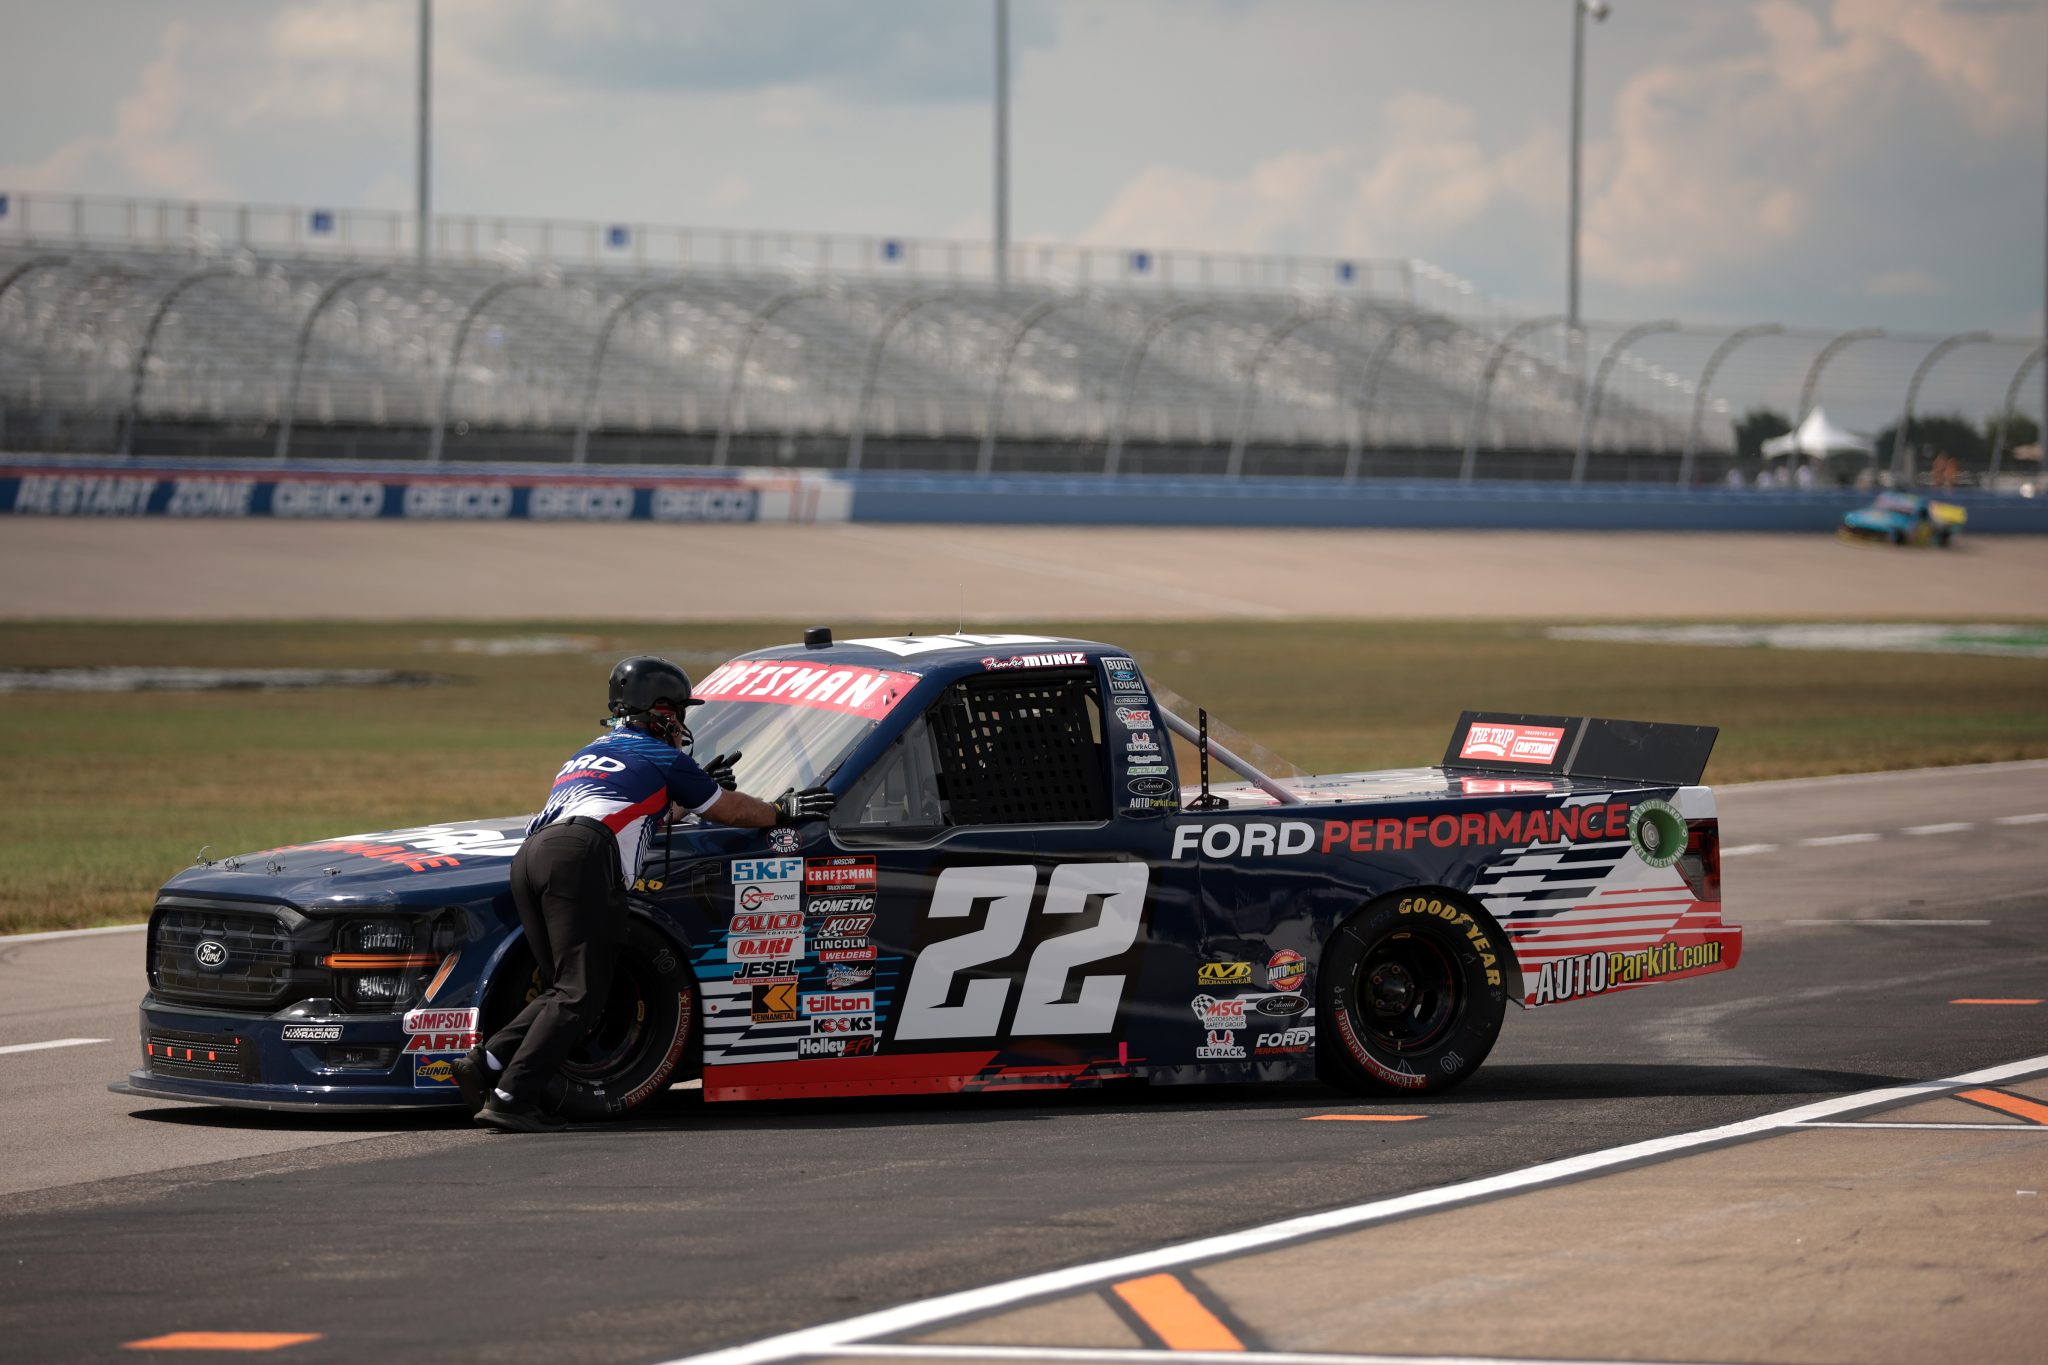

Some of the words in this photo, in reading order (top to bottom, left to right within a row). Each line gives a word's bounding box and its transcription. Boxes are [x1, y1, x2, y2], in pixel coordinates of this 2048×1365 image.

[13, 474, 158, 515] RESTART
[167, 477, 258, 516] ZONE
[271, 480, 385, 518] GEICO
[403, 482, 512, 519] GEICO
[528, 484, 635, 520] GEICO
[650, 486, 758, 521] GEICO
[1022, 653, 1085, 666] MUNIZ
[1106, 661, 1133, 670] BUILT
[692, 665, 888, 707] RAFTSMAN
[1113, 681, 1140, 689] TOUGH
[1127, 712, 1149, 720] MSG
[1468, 727, 1490, 745] THE
[1490, 728, 1514, 748] TRIP
[556, 754, 626, 779] ORD
[770, 828, 795, 837] NASCAR
[1171, 822, 1315, 859] FORD
[1321, 803, 1629, 854] PERFORMANCE
[773, 843, 798, 852] SALUTES
[734, 860, 802, 881] SKF
[808, 868, 873, 880] CRAFTSMAN
[808, 898, 873, 912] COMETIC
[731, 914, 803, 932] CALICO
[827, 918, 871, 931] KLOTZ
[814, 939, 866, 949] LINCOLN
[1399, 898, 1501, 987] GOODYEAR
[200, 945, 221, 962] Ford
[825, 951, 872, 959] WELDERS
[894, 862, 1149, 1040] 22
[734, 961, 797, 978] JESEL
[807, 996, 870, 1012] tilton
[1206, 1002, 1243, 1016] MSG
[409, 1013, 473, 1029] SIMPSON
[752, 1012, 795, 1021] KENNAMETAL
[678, 1007, 691, 1046] HONOR
[814, 1017, 872, 1033] KOOKS
[406, 1034, 482, 1050] ARP
[1256, 1031, 1310, 1047] FORD
[1339, 1012, 1368, 1064] REMEMBER
[800, 1038, 845, 1056] Holley
[1198, 1048, 1242, 1056] LEVRACK
[1254, 1046, 1309, 1055] PERFORMANCE
[418, 1067, 453, 1075] SUNO
[1378, 1070, 1412, 1087] HONOR
[630, 1060, 673, 1103] REMEMBER
